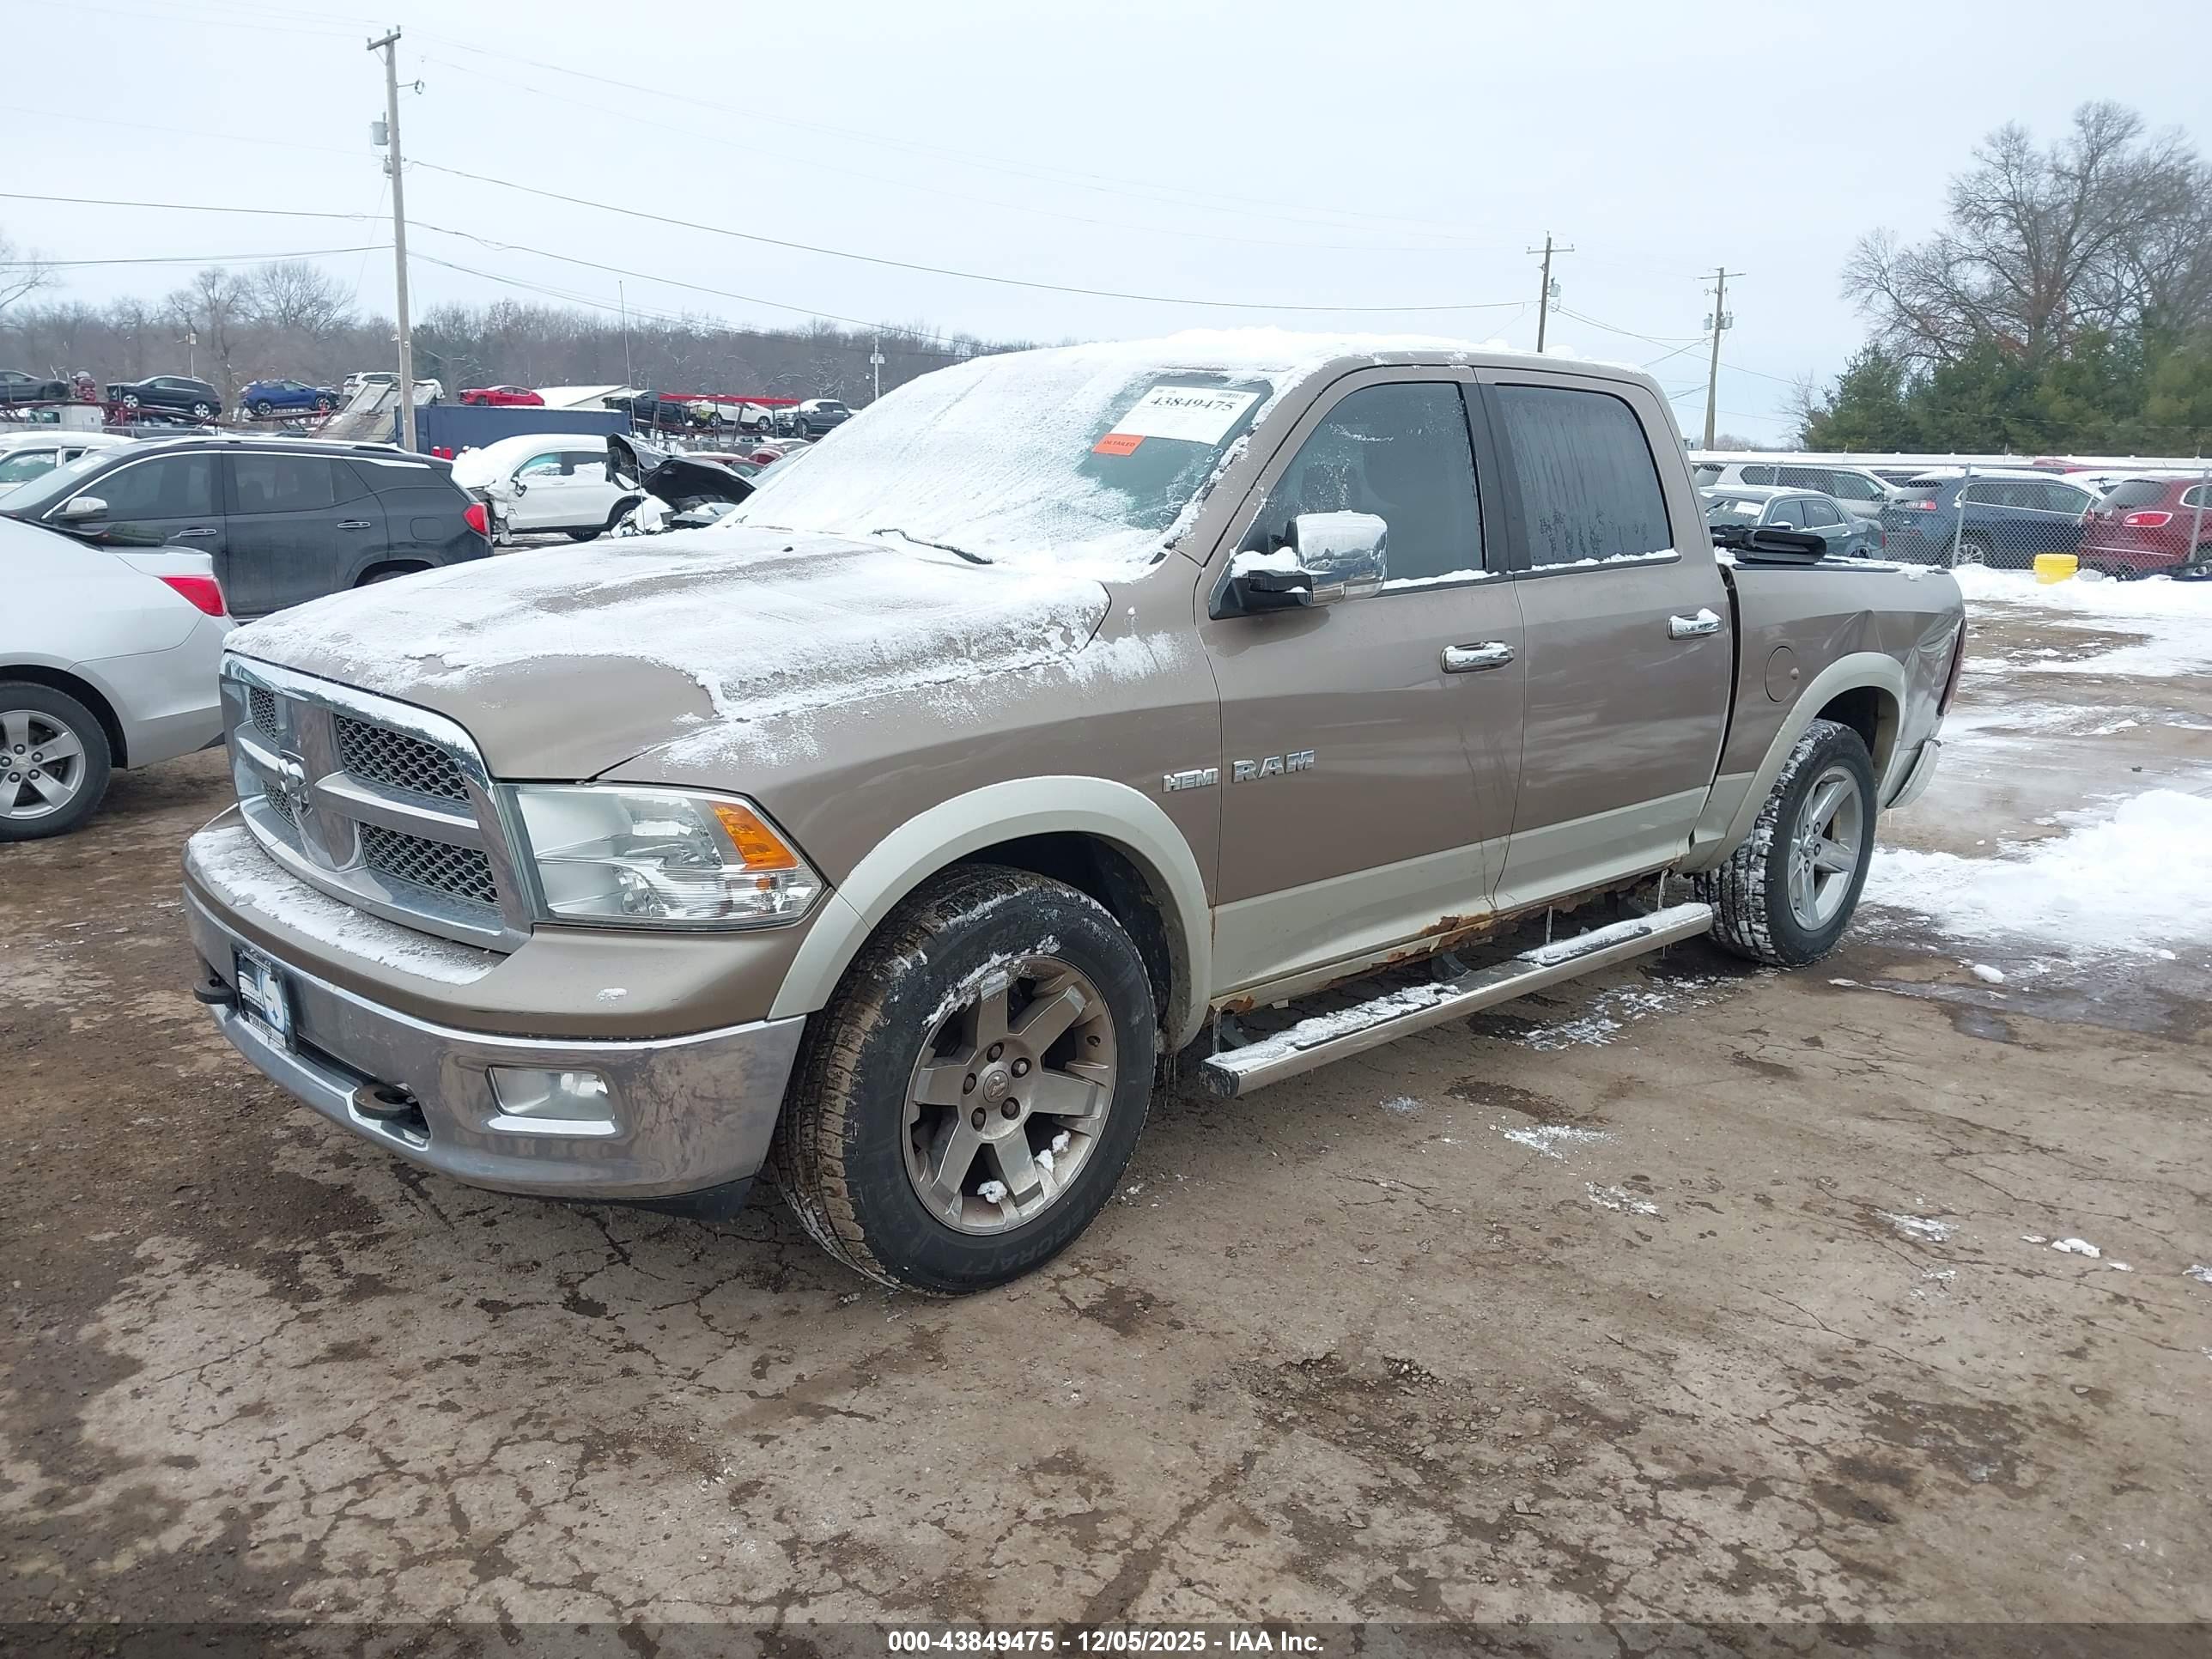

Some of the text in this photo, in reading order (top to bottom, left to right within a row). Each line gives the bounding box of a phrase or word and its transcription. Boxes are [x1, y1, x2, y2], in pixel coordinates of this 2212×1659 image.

[1151, 396, 1237, 411] 43849475
[1232, 750, 1315, 783] RAM
[1163, 768, 1218, 793] HEMI
